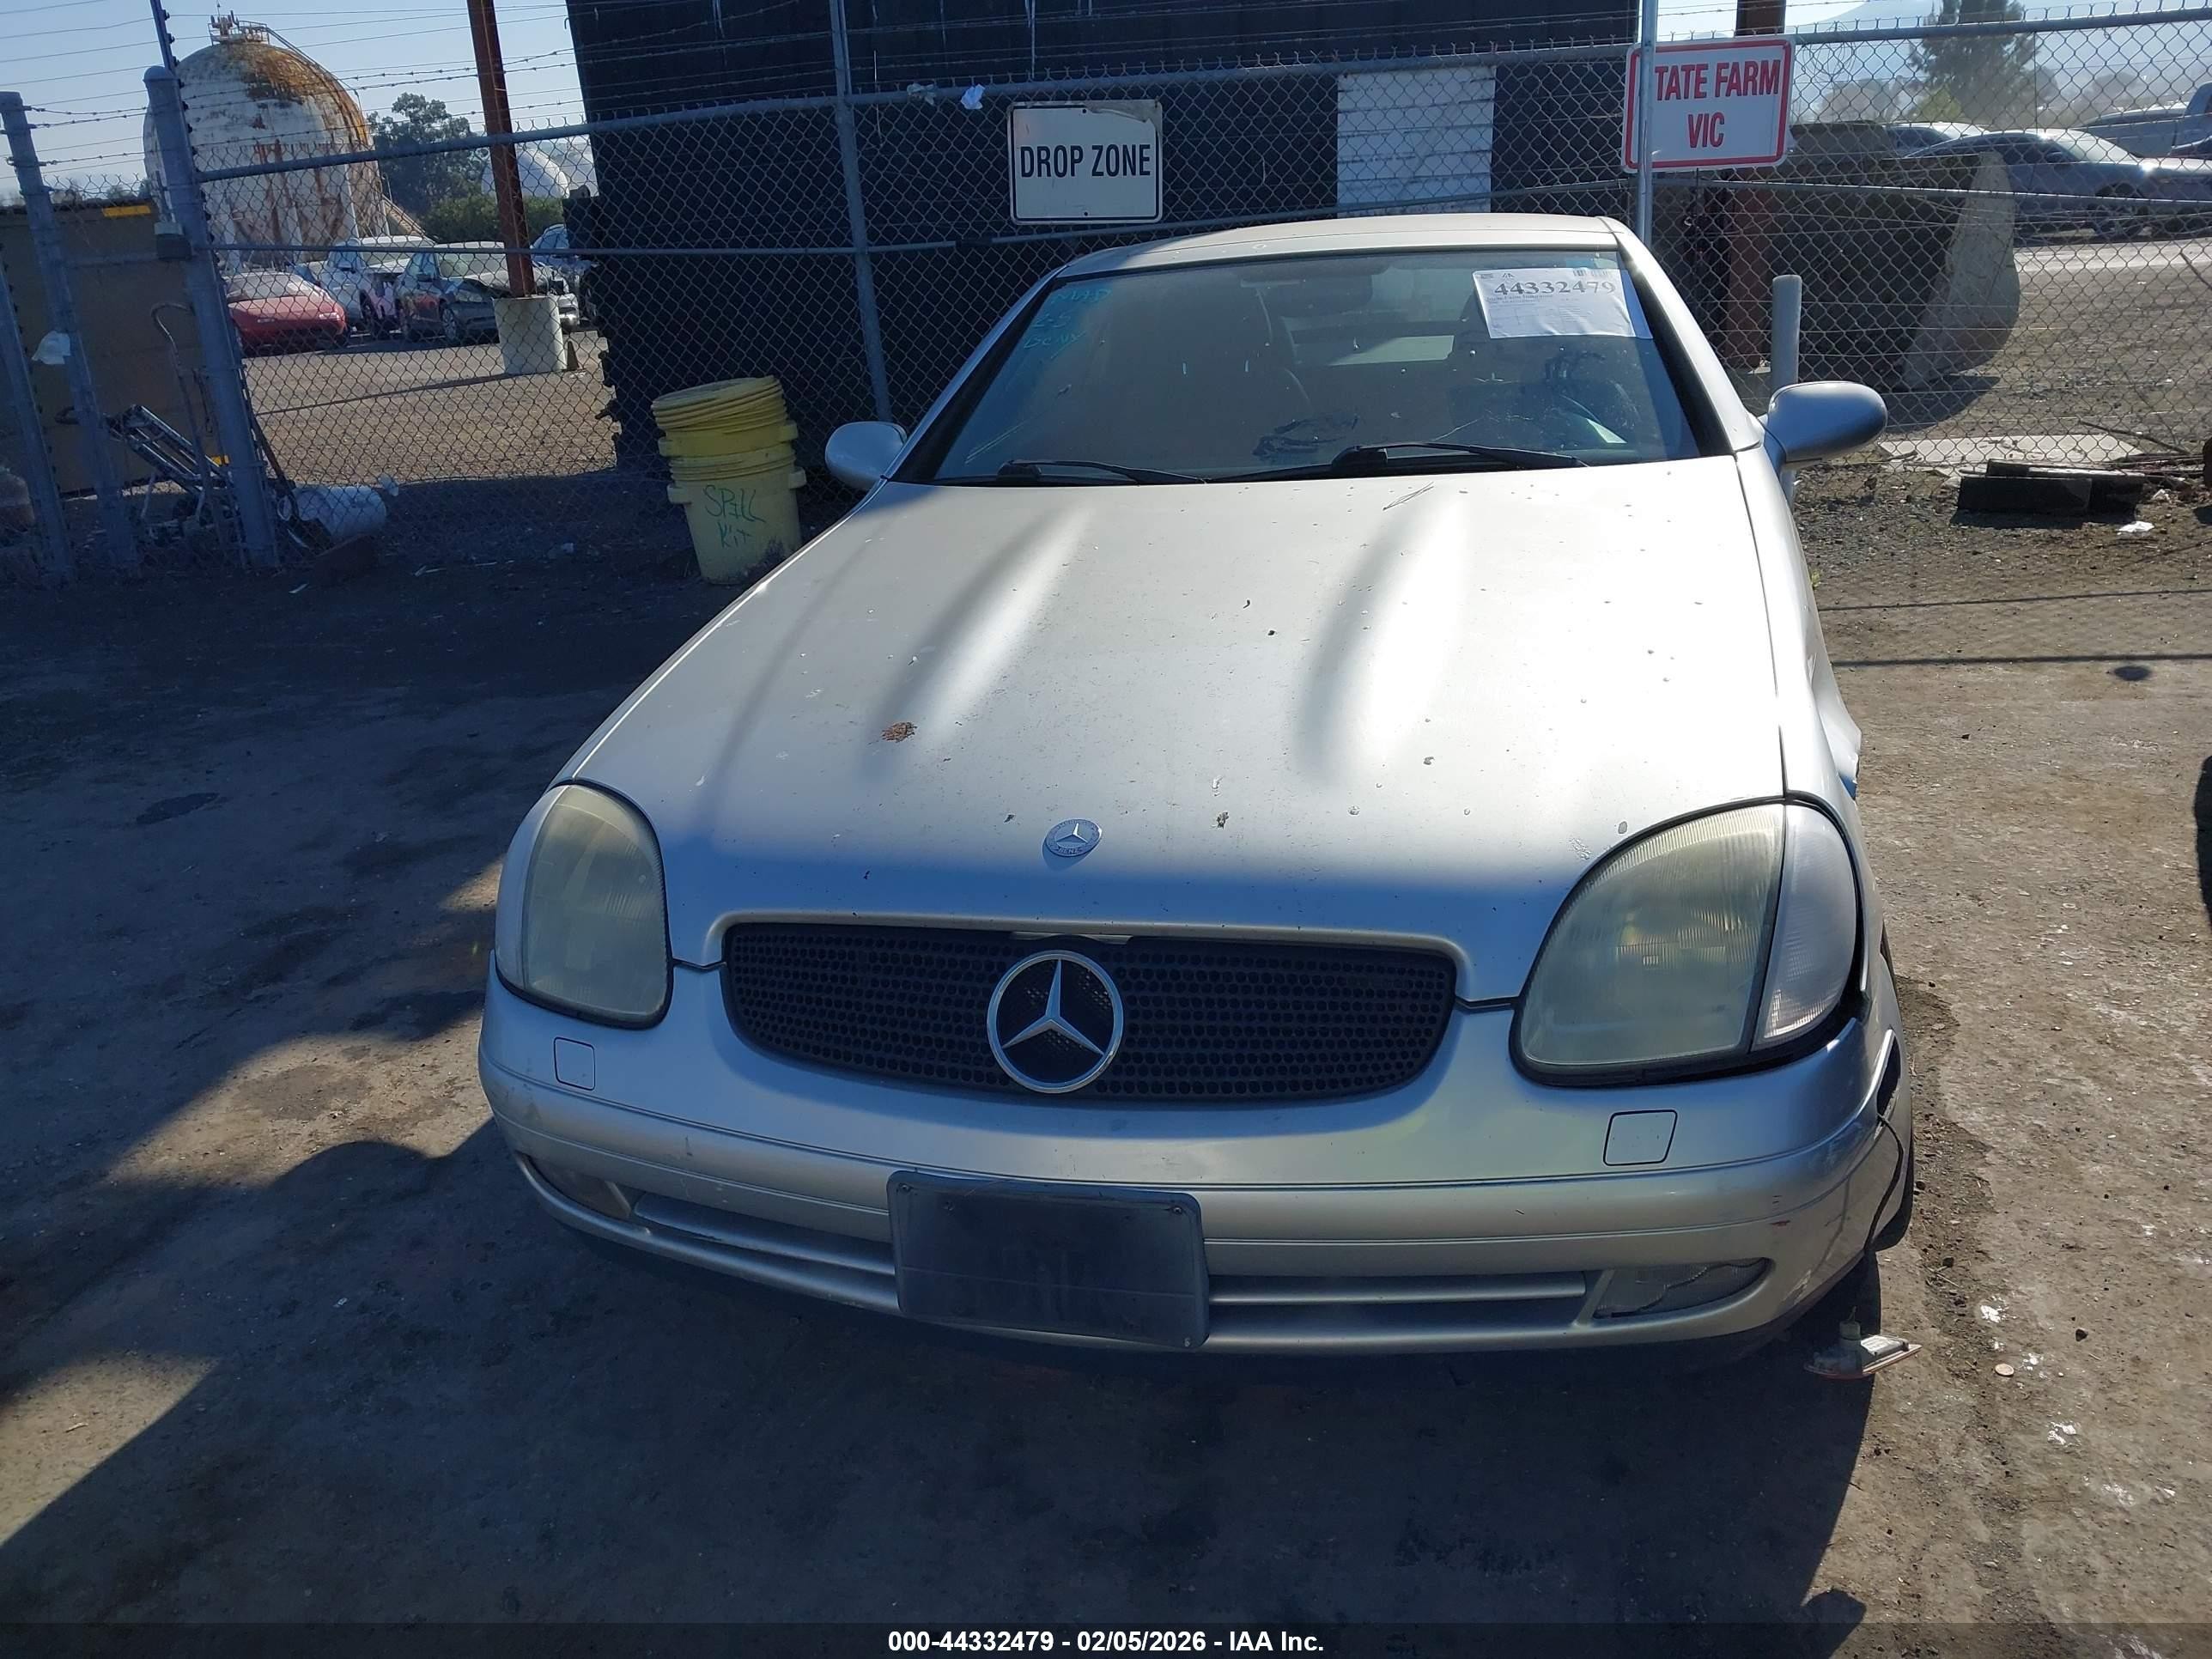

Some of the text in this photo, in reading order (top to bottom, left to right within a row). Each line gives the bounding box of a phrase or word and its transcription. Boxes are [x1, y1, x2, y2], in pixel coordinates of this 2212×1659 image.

[1654, 59, 1781, 101] TATE FARM
[1687, 112, 1725, 149] VIC
[1020, 144, 1151, 178] DROP ZONE
[1494, 280, 1616, 295] 44332479
